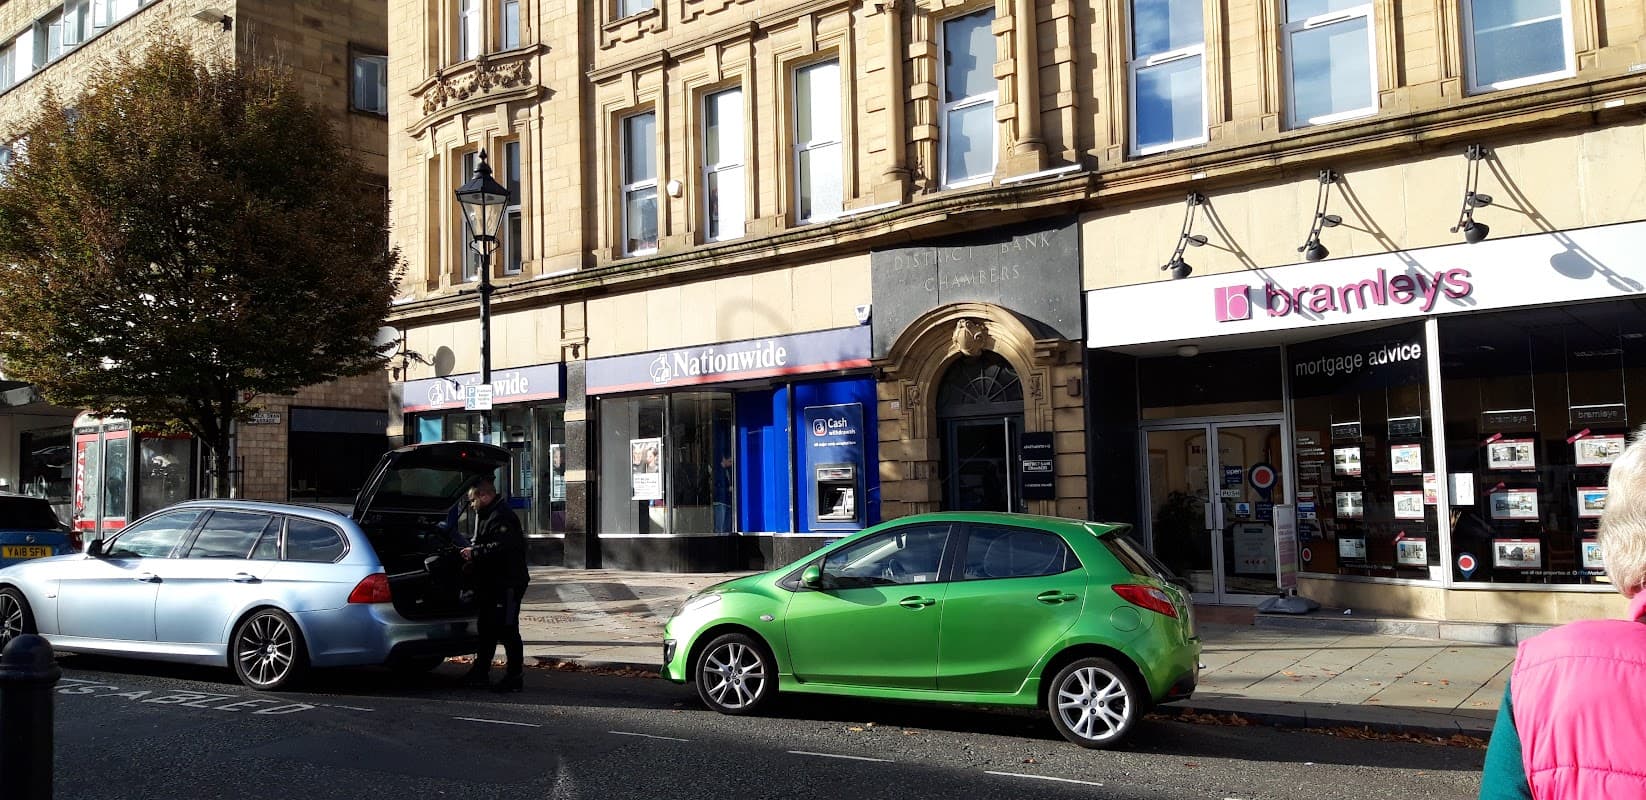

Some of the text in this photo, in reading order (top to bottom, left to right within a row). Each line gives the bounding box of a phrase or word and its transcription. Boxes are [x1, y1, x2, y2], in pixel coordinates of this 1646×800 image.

[894, 232, 1050, 271] DISTRICT BANK
[924, 264, 1021, 292] CHAMBERS
[1265, 267, 1474, 317] bramleys
[672, 340, 787, 378] Nationwide
[1295, 342, 1422, 377] mortgage advice
[445, 371, 529, 401] Nawide
[827, 417, 848, 429] Cash
[8, 547, 46, 557] YA18 SFN
[48, 682, 315, 715] ISABLED
